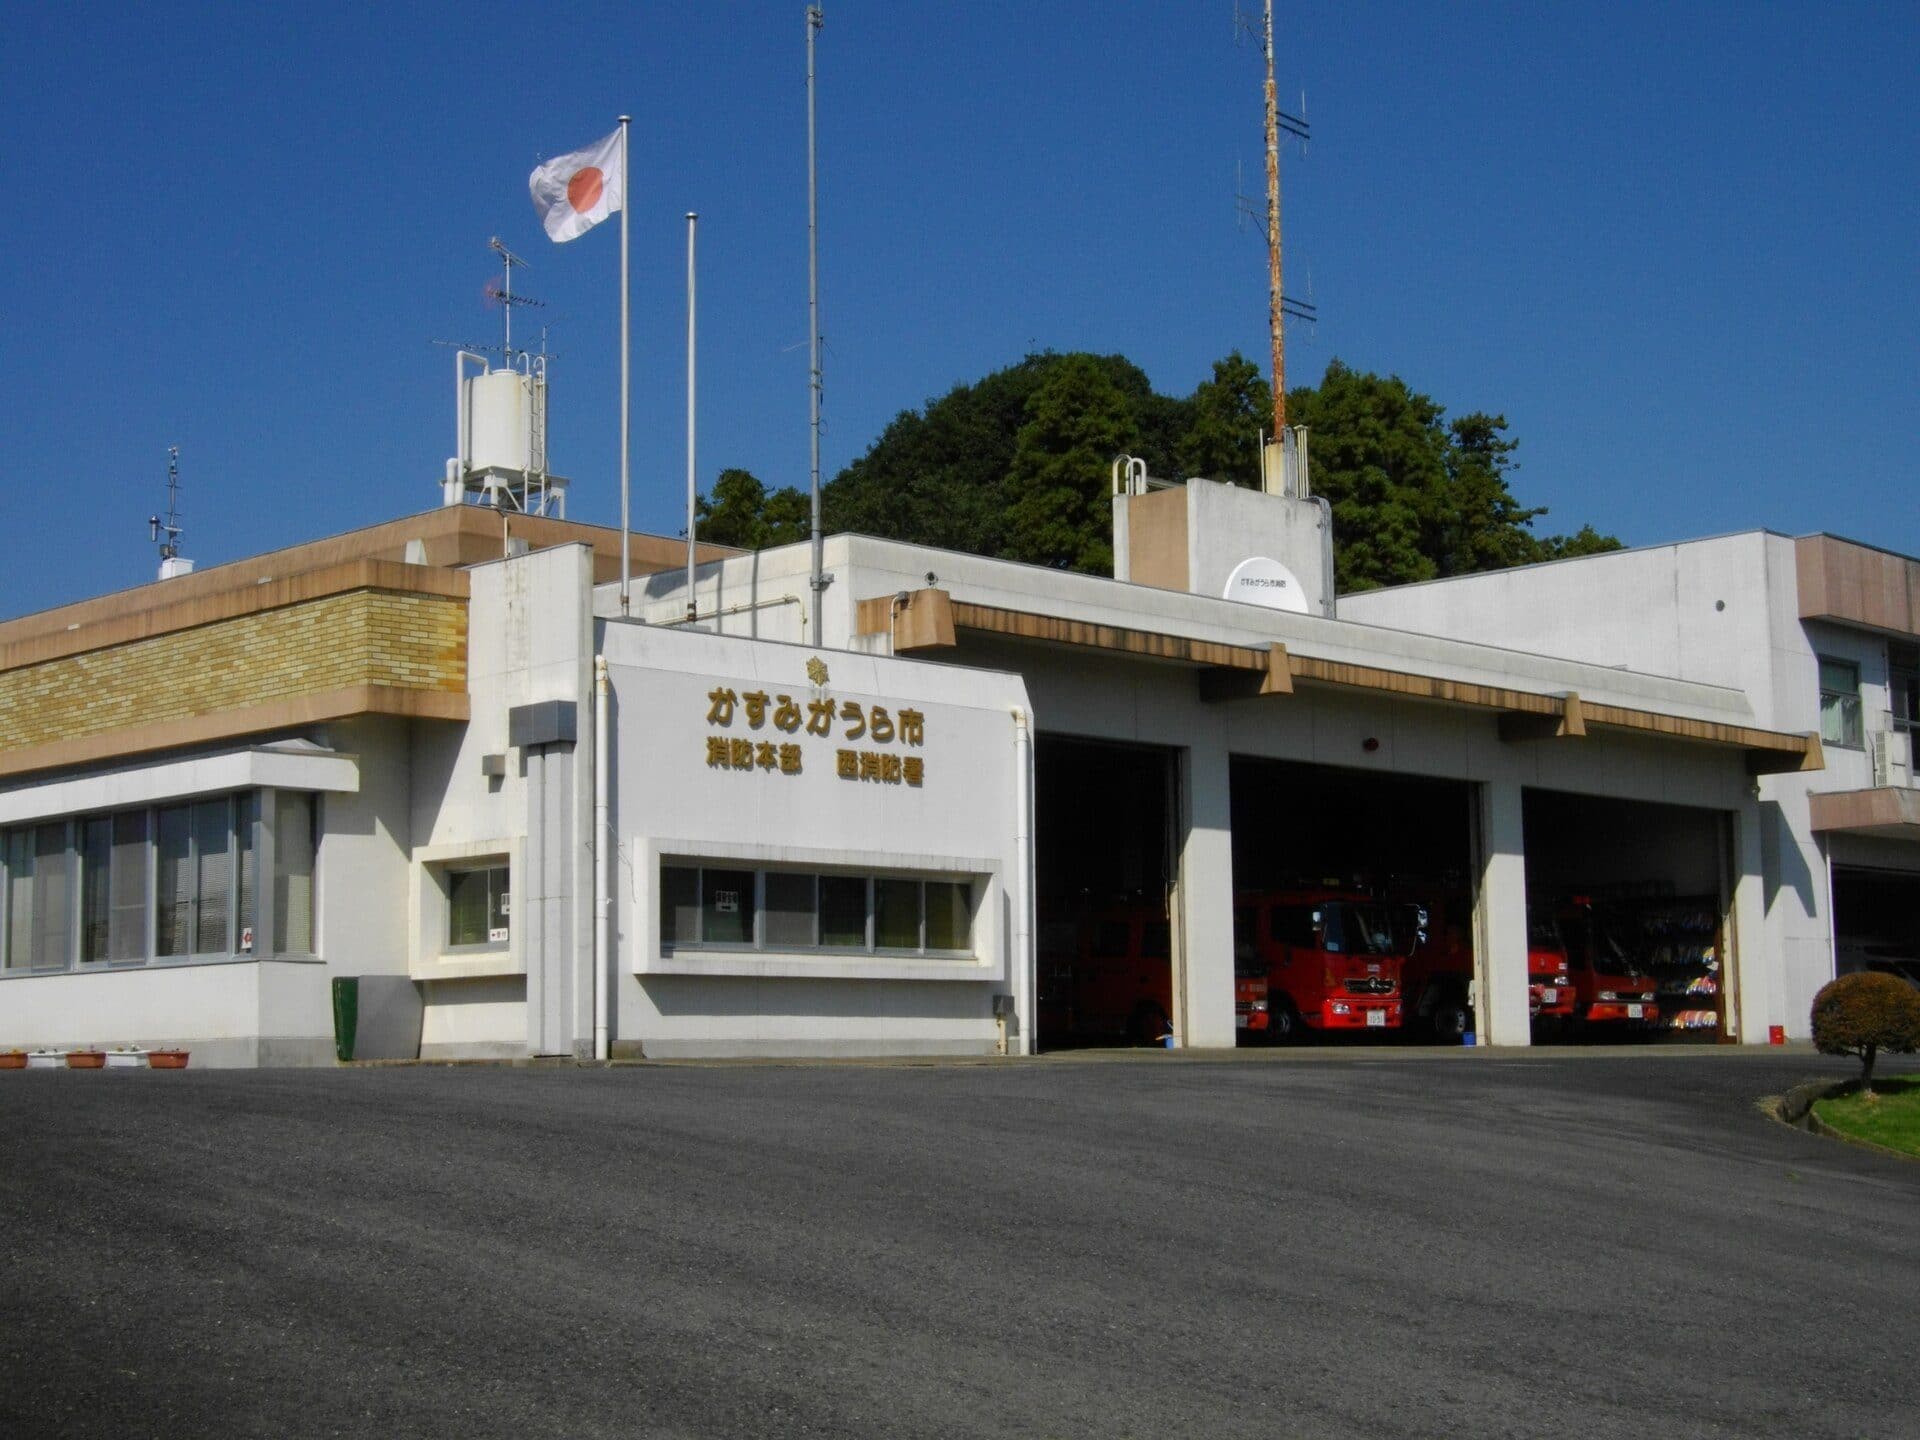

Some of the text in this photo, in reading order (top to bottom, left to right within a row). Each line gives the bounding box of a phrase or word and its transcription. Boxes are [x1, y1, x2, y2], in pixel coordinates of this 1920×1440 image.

[706, 686, 924, 747] かすみがうら市
[706, 736, 924, 787] 消防本部 西消防署
